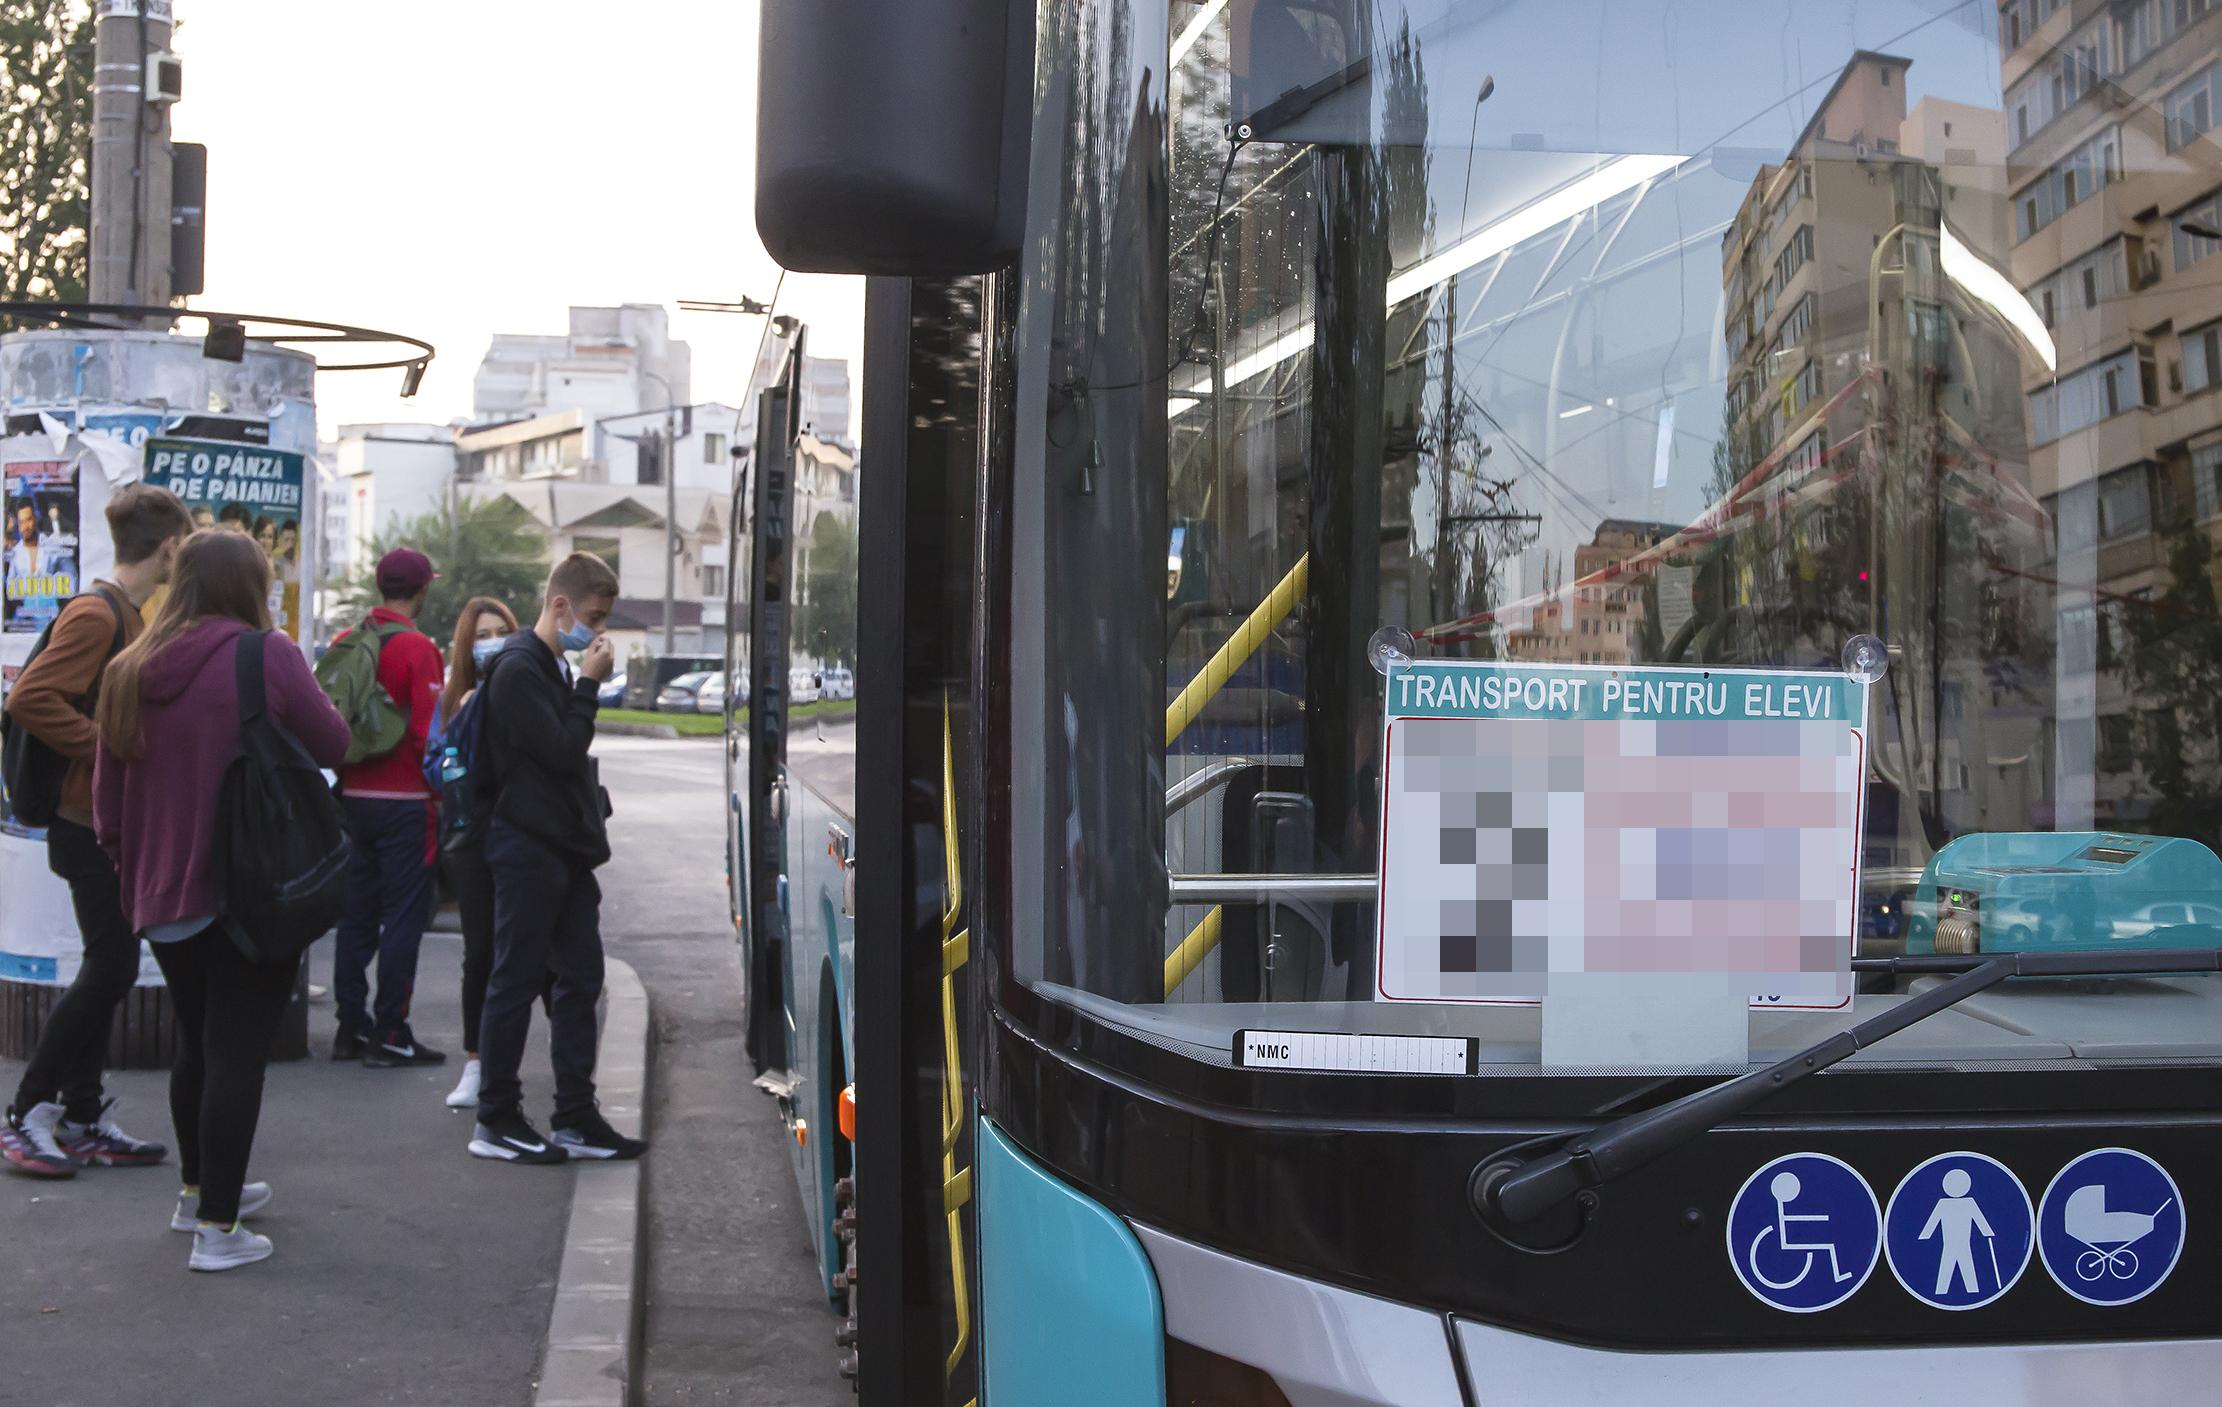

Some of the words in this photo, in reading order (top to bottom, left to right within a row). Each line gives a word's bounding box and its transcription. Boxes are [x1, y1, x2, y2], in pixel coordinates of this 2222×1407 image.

[152, 452, 187, 474] PE
[191, 453, 210, 475] O
[169, 477, 203, 500] DE
[1396, 674, 1587, 712] TRANSPORT
[1602, 679, 1727, 716] PENTRU
[1744, 683, 1831, 719] ELEVI
[1257, 1044, 1289, 1060] NMC
